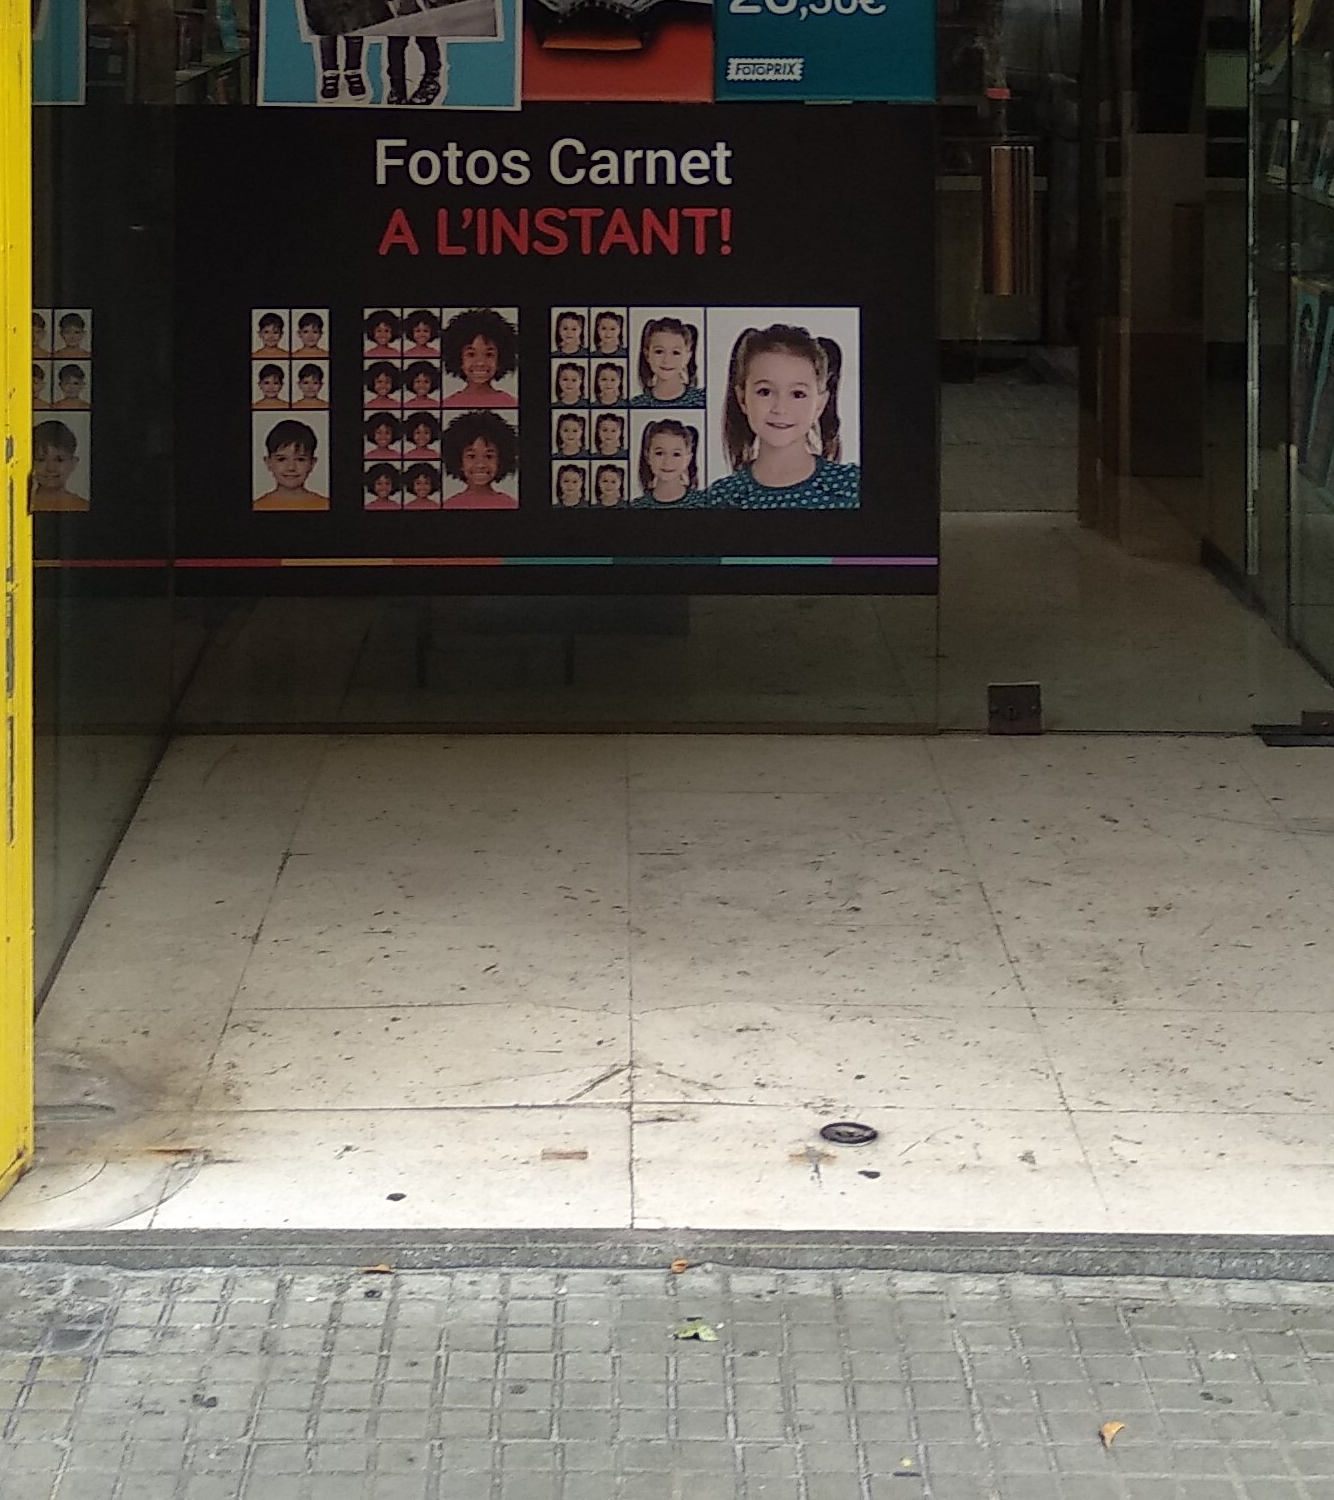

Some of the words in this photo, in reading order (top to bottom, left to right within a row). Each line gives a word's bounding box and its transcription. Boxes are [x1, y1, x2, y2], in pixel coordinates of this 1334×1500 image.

[376, 138, 531, 185] Fotos
[549, 138, 732, 185] Carnet
[379, 208, 419, 255] A
[437, 208, 732, 255] L'INSTANT!
